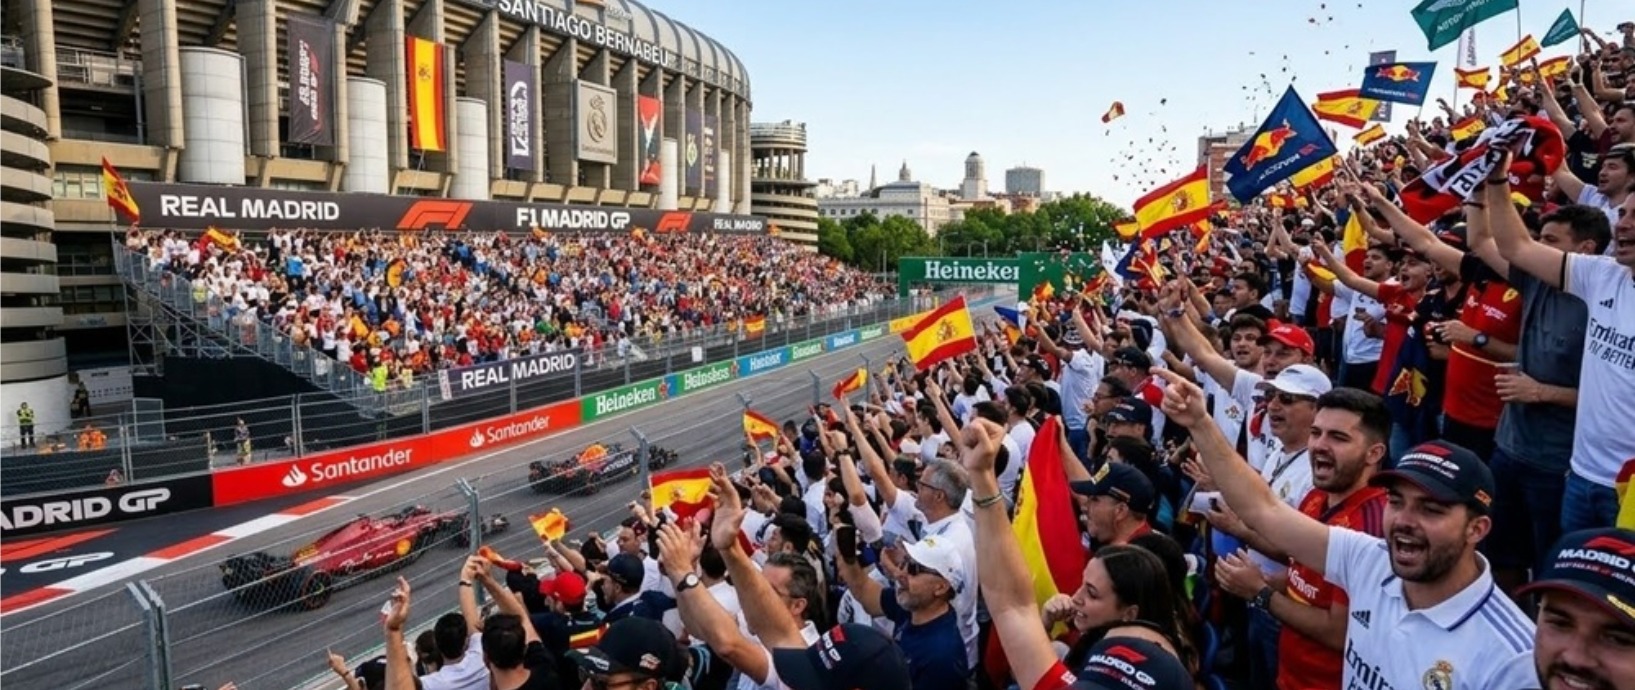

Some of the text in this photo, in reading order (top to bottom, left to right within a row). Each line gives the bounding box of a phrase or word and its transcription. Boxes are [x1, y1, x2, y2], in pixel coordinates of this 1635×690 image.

[499, 0, 591, 39] SANTIAGO
[160, 194, 340, 221] REAL MADRID
[516, 207, 631, 230] F1 MADRID GP
[461, 366, 509, 390] REAL
[512, 353, 575, 380] MADRID
[595, 386, 656, 416] Heineken
[486, 415, 550, 444] Santander
[311, 448, 413, 482] Santander
[119, 487, 171, 513] GP
[19, 551, 115, 574] GP
